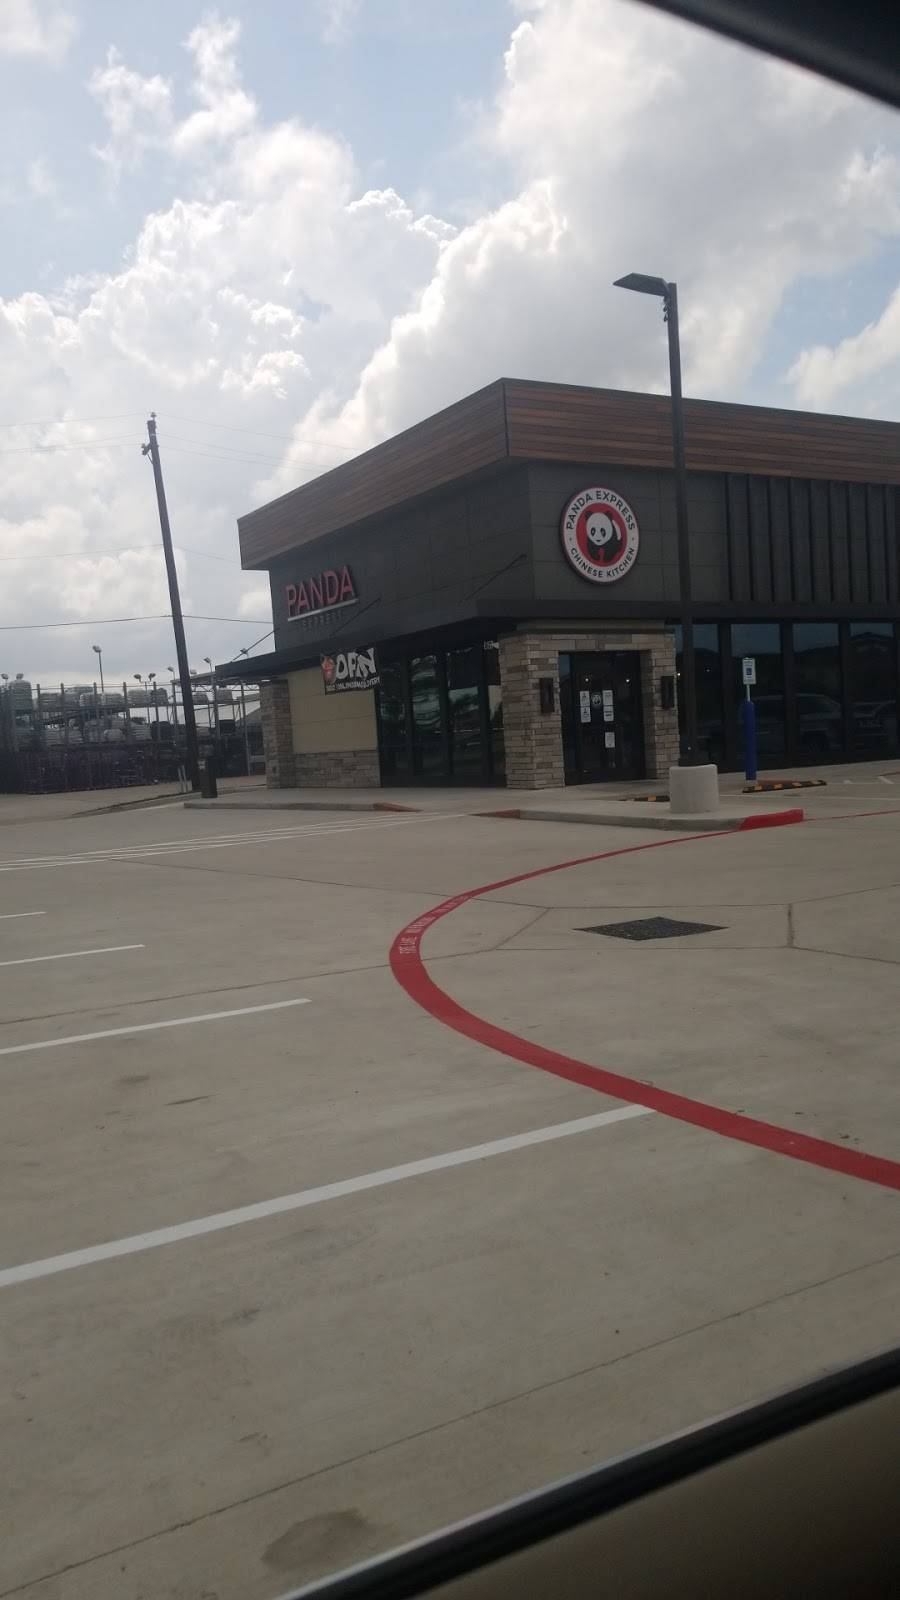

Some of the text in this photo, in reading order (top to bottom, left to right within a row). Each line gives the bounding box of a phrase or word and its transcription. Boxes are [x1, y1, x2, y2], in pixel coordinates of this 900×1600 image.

[566, 490, 636, 531] PANDA EXPRESS
[570, 547, 635, 578] CHINESE KITCHEN
[285, 565, 356, 617] PANDA
